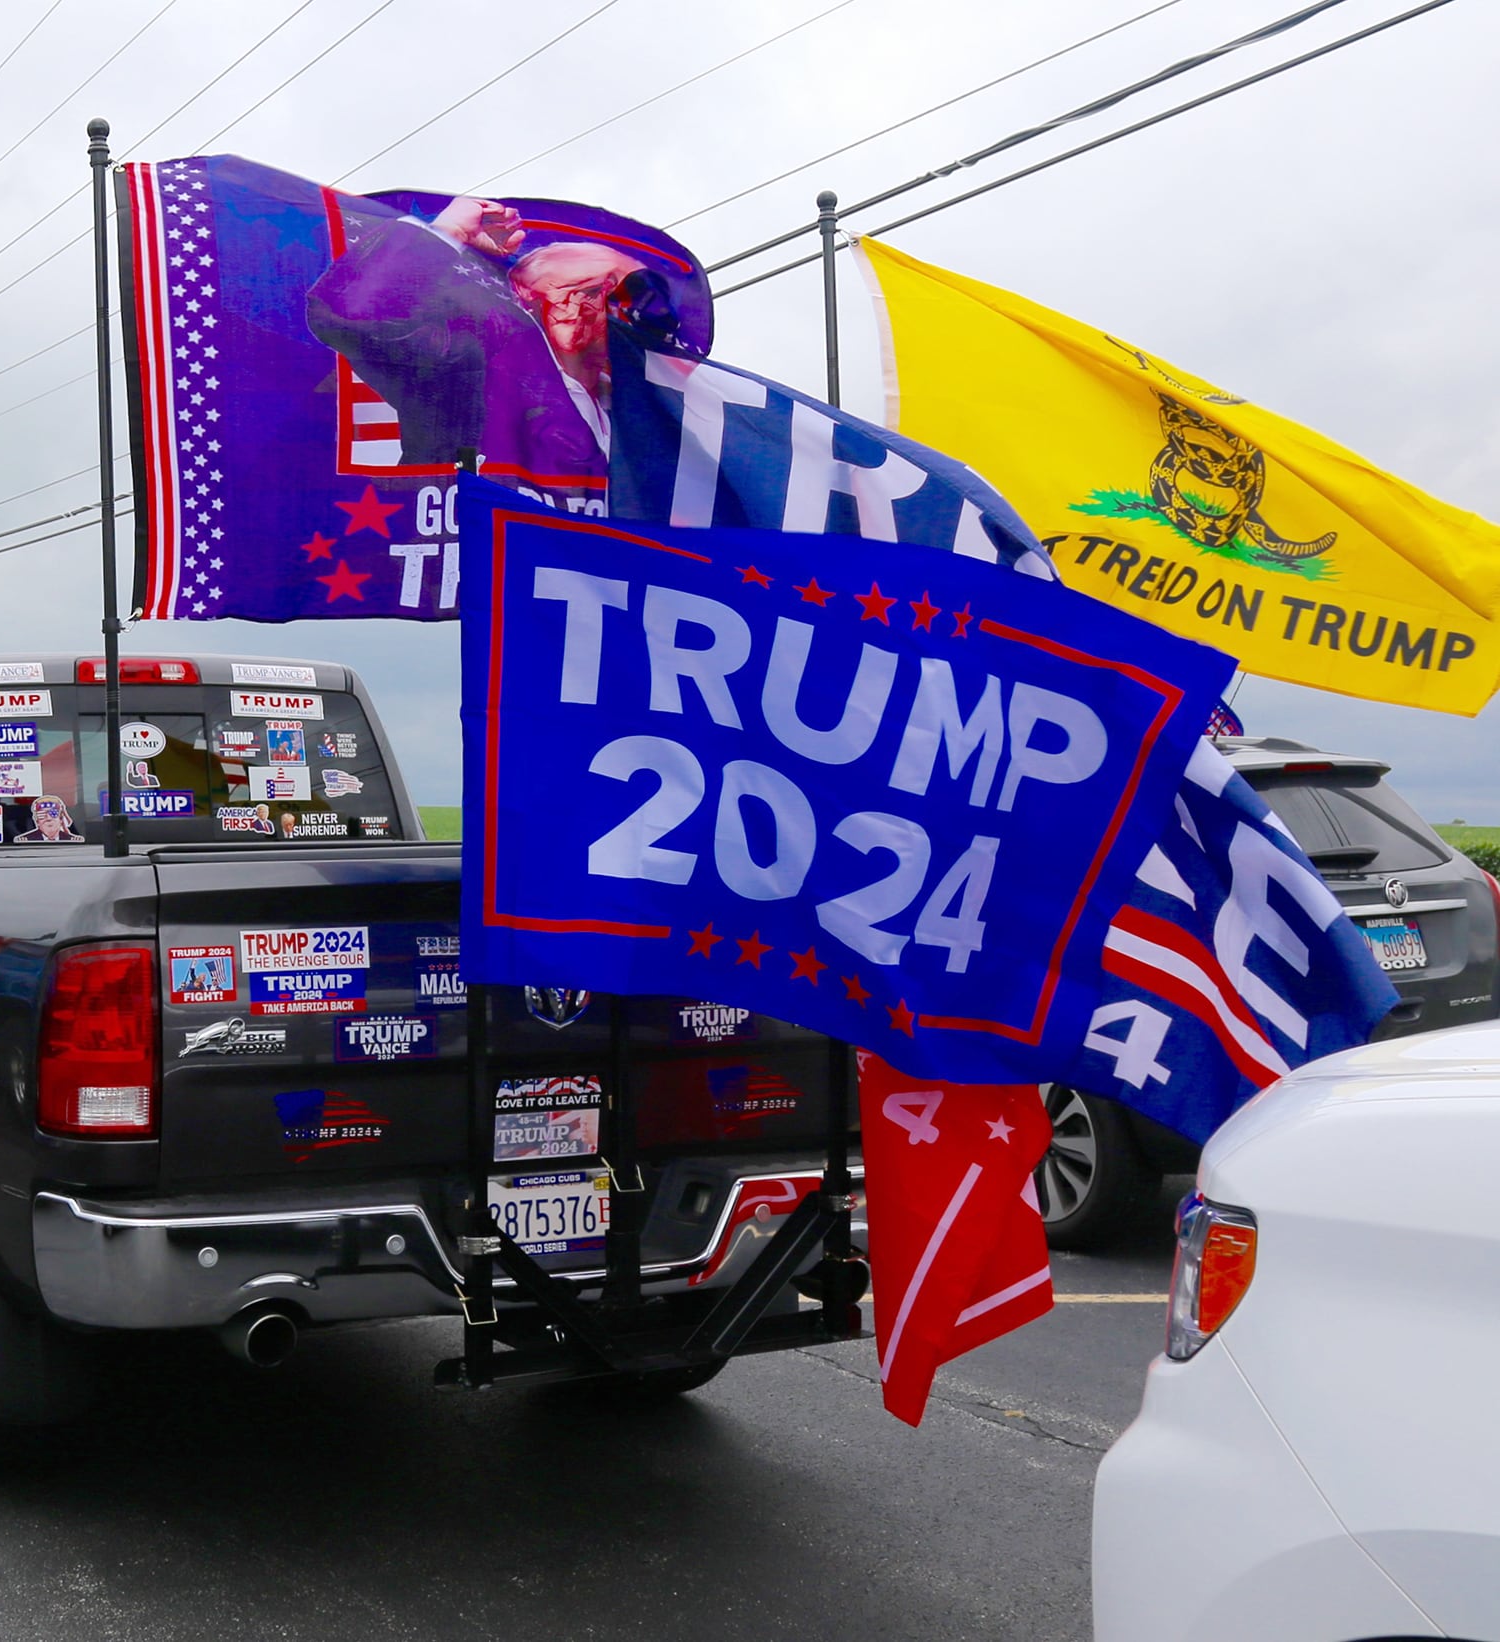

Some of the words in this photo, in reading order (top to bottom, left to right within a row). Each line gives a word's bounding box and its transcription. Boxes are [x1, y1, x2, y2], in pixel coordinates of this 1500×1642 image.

[1196, 579, 1265, 632] ON
[1280, 596, 1476, 673] TRUMP
[533, 566, 1109, 813] TRUMP
[240, 695, 314, 709] TRUMP
[267, 721, 302, 730] TRUMP
[132, 731, 137, 739] I
[222, 731, 254, 745] TRUMP
[122, 740, 159, 748] TRUMP
[124, 796, 188, 812] RUMP
[218, 807, 258, 818] AMERICA
[301, 812, 339, 825] NEVER
[223, 817, 254, 830] FIRST
[359, 816, 388, 824] TRUMP
[294, 824, 348, 837] SURRENDER
[587, 735, 1000, 974] 2024
[1366, 917, 1404, 928] NAPERVILLE
[243, 933, 309, 956] TRUMP
[312, 931, 365, 953] 2024
[1382, 931, 1422, 958] 60899
[171, 948, 206, 957] TRUMP
[208, 947, 232, 956] 2024
[247, 957, 272, 969] THE
[274, 954, 329, 968] REVENGE
[332, 953, 365, 966] TOUR
[1380, 957, 1427, 970] OODY
[263, 974, 353, 991] TRUMP
[420, 972, 467, 995] MAG
[183, 991, 224, 1002] FIGHT!
[293, 990, 323, 1000] 2024
[1449, 994, 1492, 1007] ENCORE
[262, 1002, 285, 1013] TAKE
[287, 1001, 329, 1013] AMERICA
[331, 1000, 354, 1011] BACK
[679, 1007, 750, 1028] TRUMP
[246, 1033, 277, 1042] BIG
[345, 1024, 427, 1045] TRUMP
[694, 1025, 735, 1038] VANCE
[363, 1043, 410, 1055] VANCE
[495, 1075, 602, 1098] AMERICA
[495, 1097, 523, 1109] LOVE
[525, 1097, 535, 1107] IT
[537, 1097, 553, 1106] OR
[555, 1094, 588, 1105] LEAVE
[341, 1127, 371, 1137] 2024
[496, 1125, 570, 1145] TRUMP
[541, 1141, 578, 1154] 2024
[519, 1174, 556, 1186] CHICAGO
[558, 1174, 581, 1183] CUBS
[544, 1241, 567, 1252] SERIES
